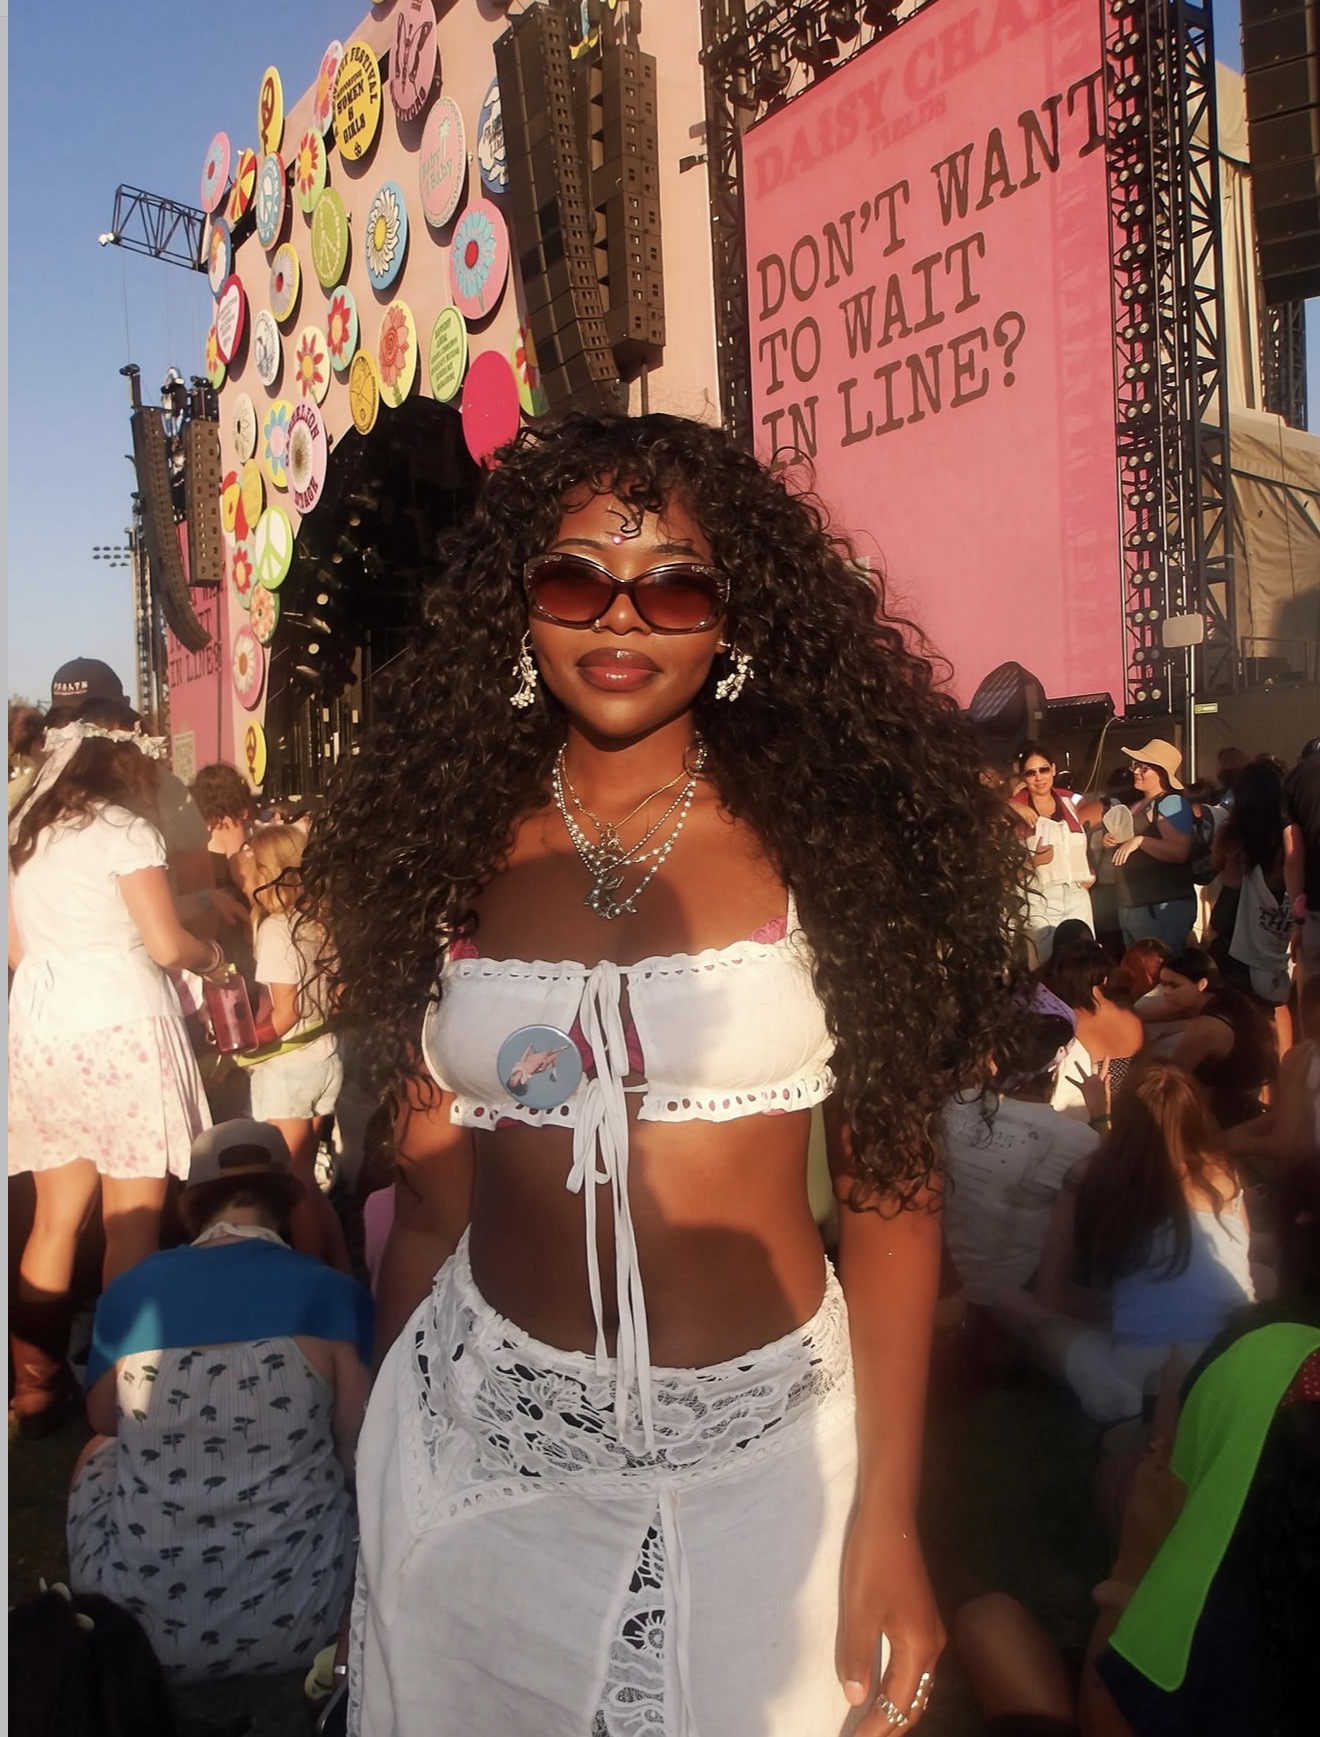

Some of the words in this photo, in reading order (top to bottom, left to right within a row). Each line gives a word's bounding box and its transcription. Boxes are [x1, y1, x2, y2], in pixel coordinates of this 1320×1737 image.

[342, 113, 367, 144] GIRLS
[753, 68, 894, 201] DAISY
[757, 179, 910, 322] DON'T
[930, 61, 1112, 227] WANT
[759, 316, 822, 395] TO
[839, 231, 985, 359] WAIT
[761, 395, 820, 473] IN
[836, 310, 1027, 448] LINE?
